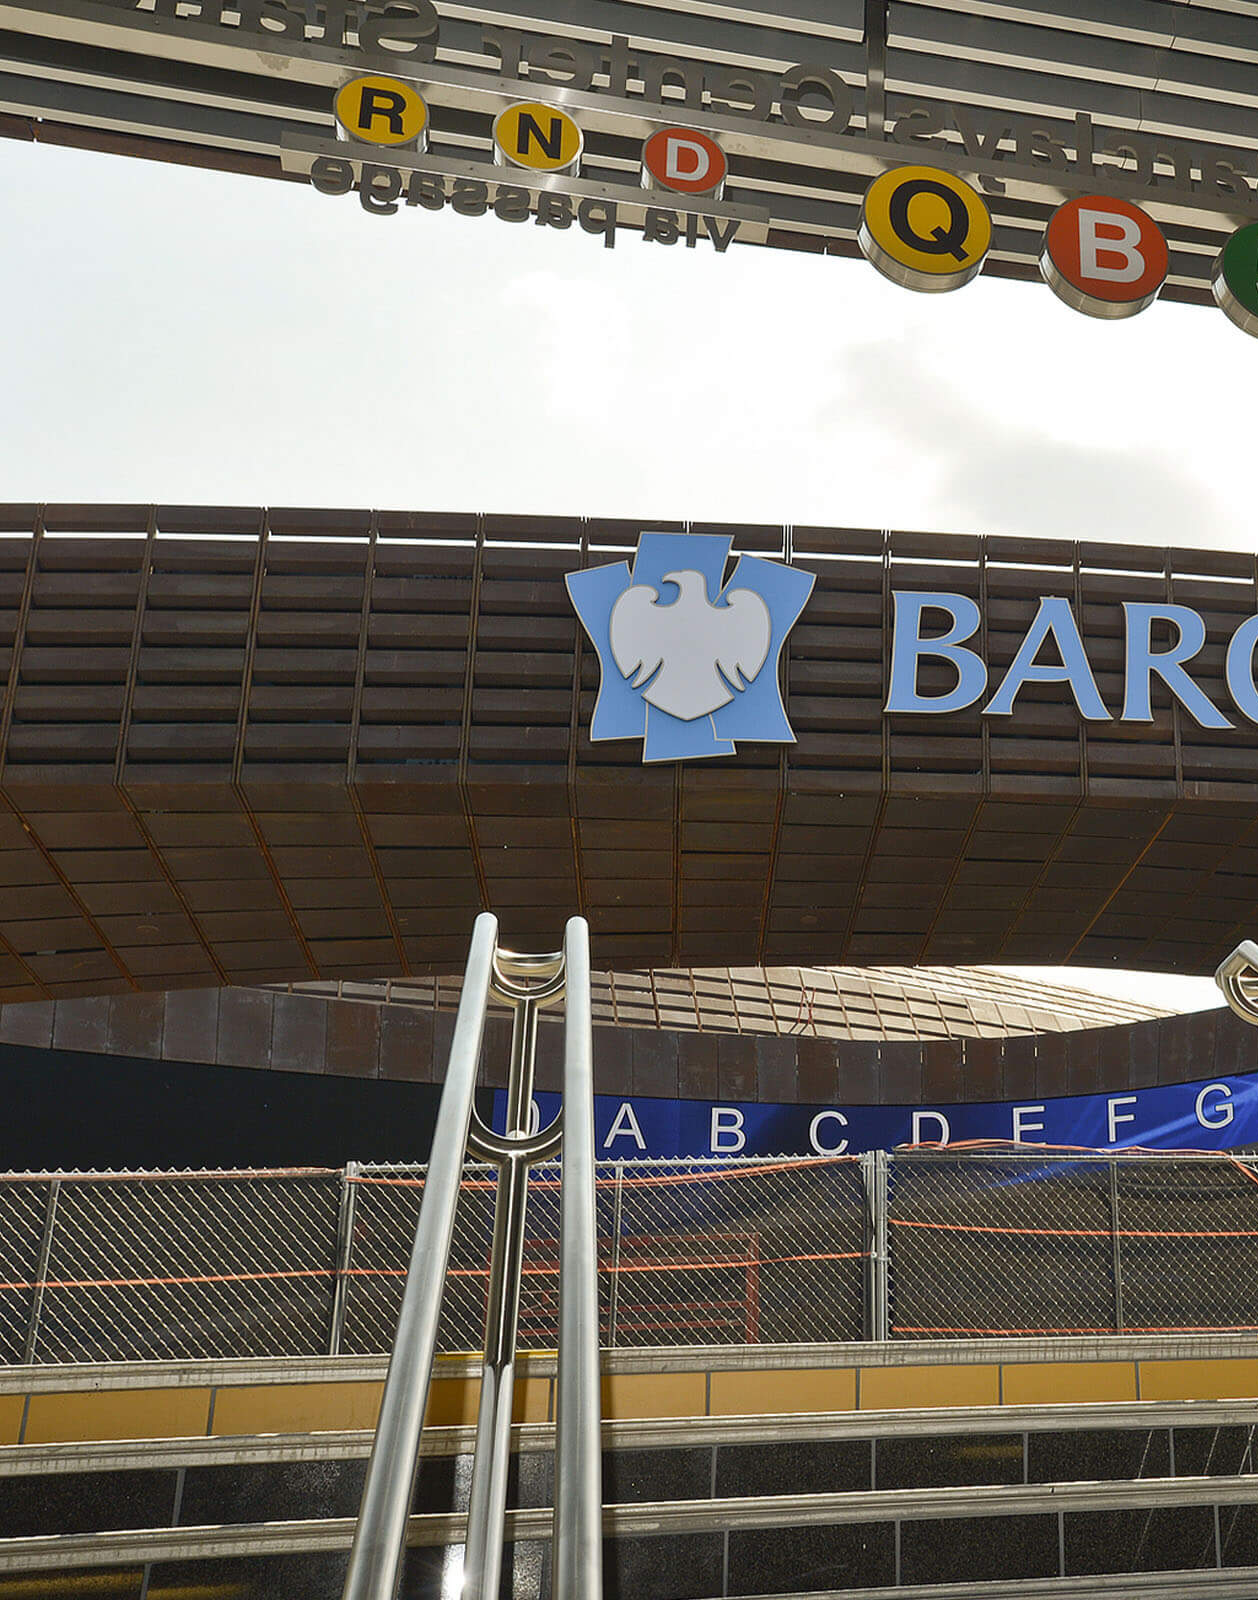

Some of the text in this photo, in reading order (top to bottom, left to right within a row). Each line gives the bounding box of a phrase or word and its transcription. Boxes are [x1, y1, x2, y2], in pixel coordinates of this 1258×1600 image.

[357, 86, 710, 182] R N D
[889, 178, 970, 262] Q
[1077, 208, 1146, 283] B
[602, 1102, 647, 1150] A
[710, 1106, 746, 1153] B
[809, 1110, 849, 1156] C
[911, 1111, 950, 1149] D
[1012, 1105, 1046, 1149] E
[1107, 1096, 1137, 1142] F
[1195, 1083, 1234, 1129] G
